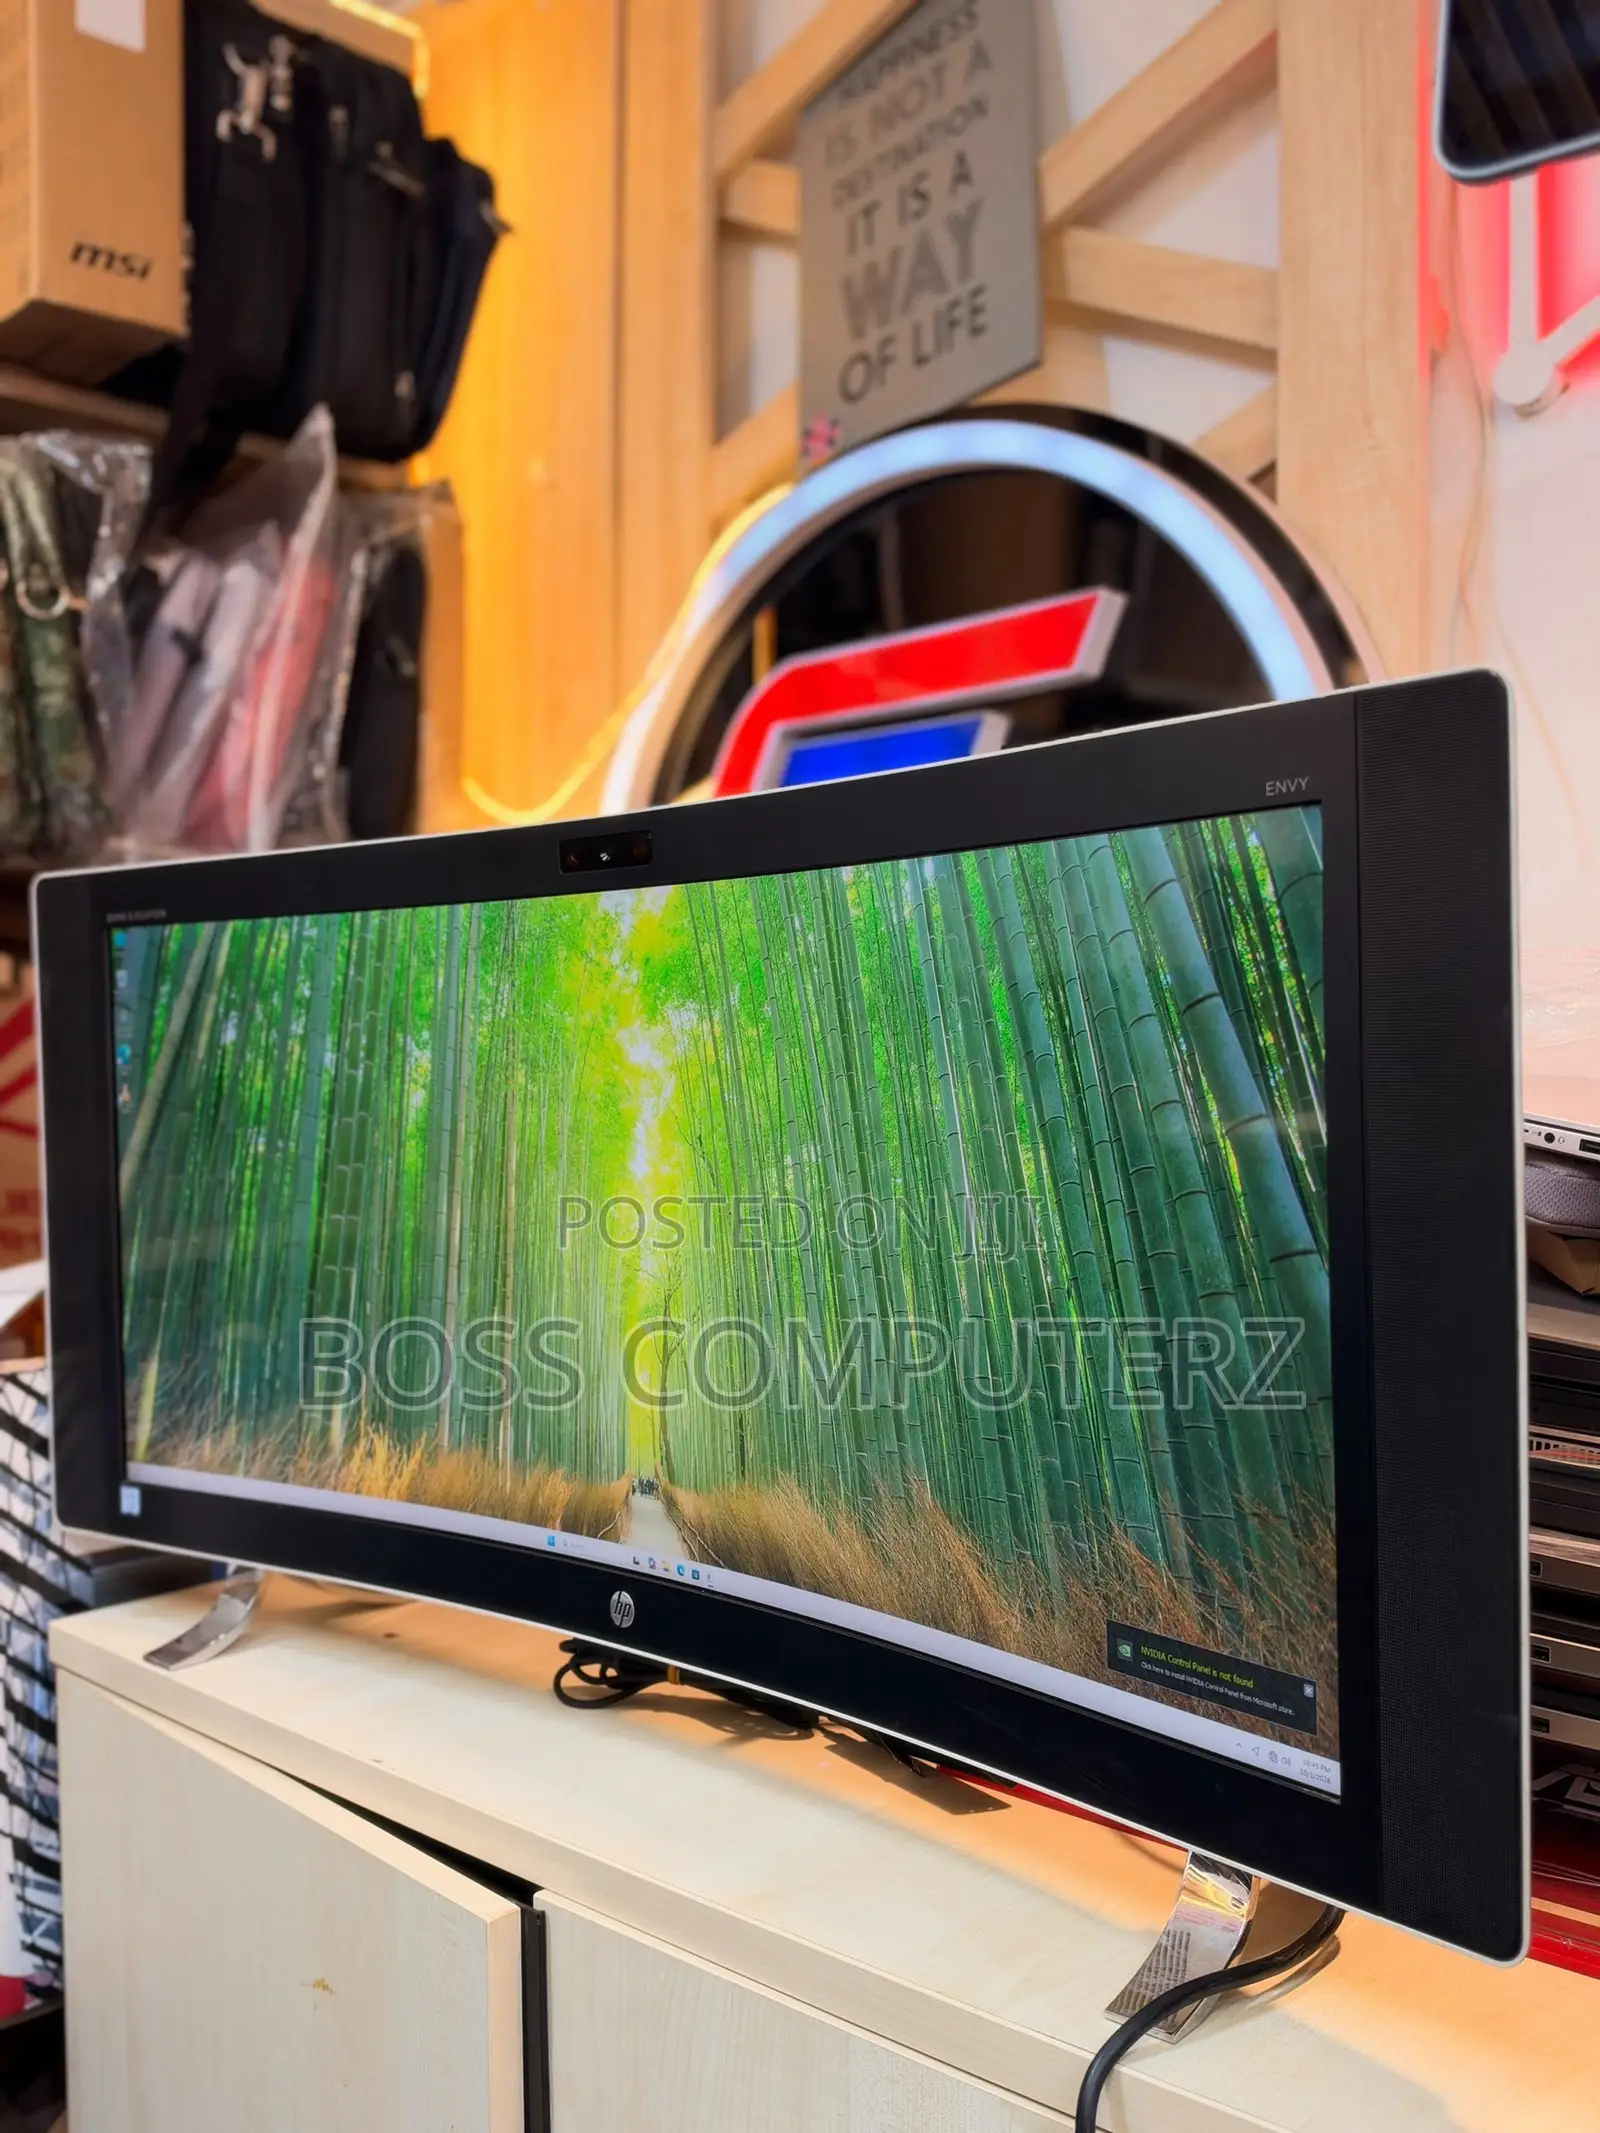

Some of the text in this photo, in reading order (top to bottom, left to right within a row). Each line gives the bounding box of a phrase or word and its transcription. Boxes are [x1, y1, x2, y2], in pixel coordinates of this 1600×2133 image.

[824, 38, 994, 171] IS NOT A
[845, 147, 975, 258] IT IS A
[70, 241, 153, 282] msi
[840, 195, 984, 342] WAY
[837, 282, 989, 404] OF LIFE
[1265, 776, 1309, 796] ENVY
[611, 1590, 634, 1628] hp
[1141, 1645, 1254, 1688] NVIDIA Control Panel is not found
[1205, 1681, 1224, 1693] Control
[1224, 1687, 1240, 1699] Panel
[1240, 1691, 1252, 1703] from
[1252, 1697, 1278, 1711] Microsoft
